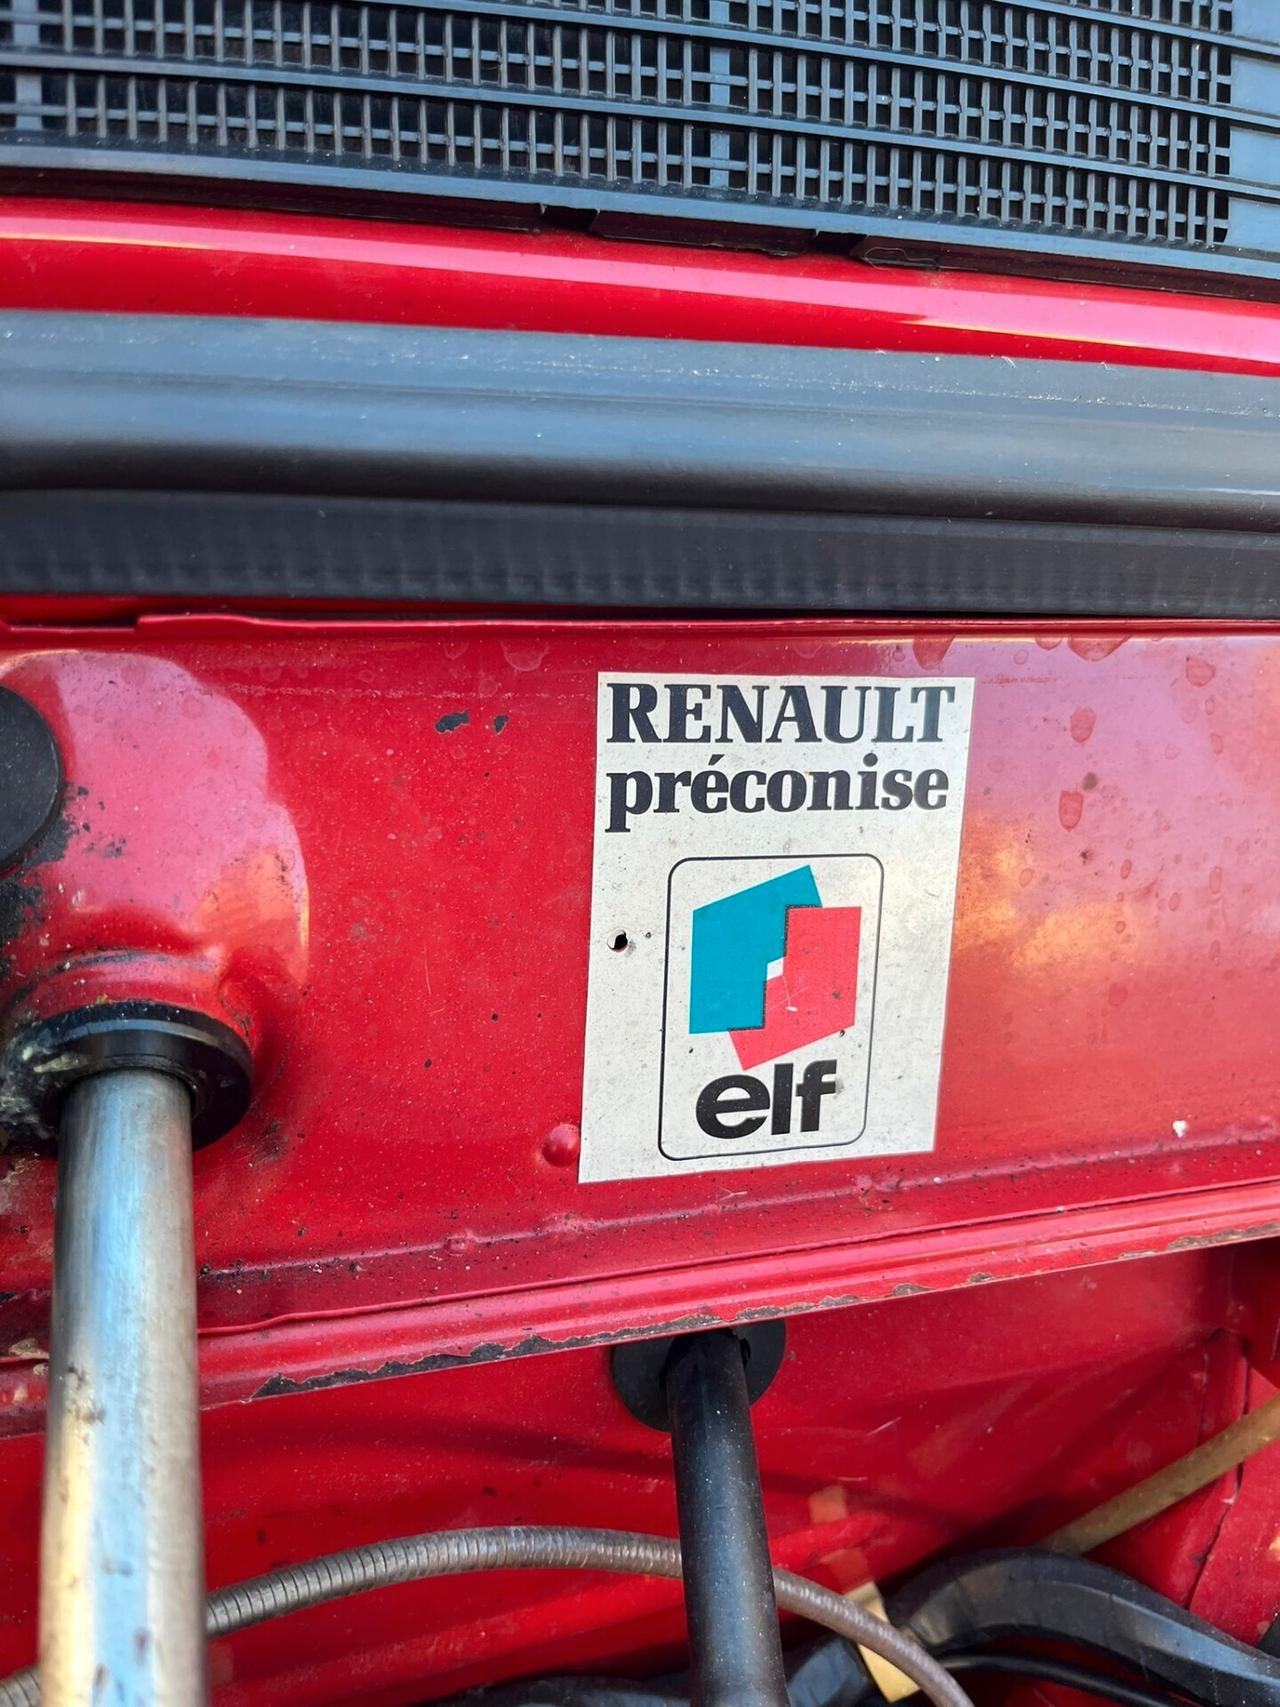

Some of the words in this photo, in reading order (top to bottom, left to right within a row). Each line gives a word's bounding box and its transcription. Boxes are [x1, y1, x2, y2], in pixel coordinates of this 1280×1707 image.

[606, 682, 956, 744] RENAULT
[604, 753, 950, 834] préconise
[695, 1059, 838, 1140] elf
